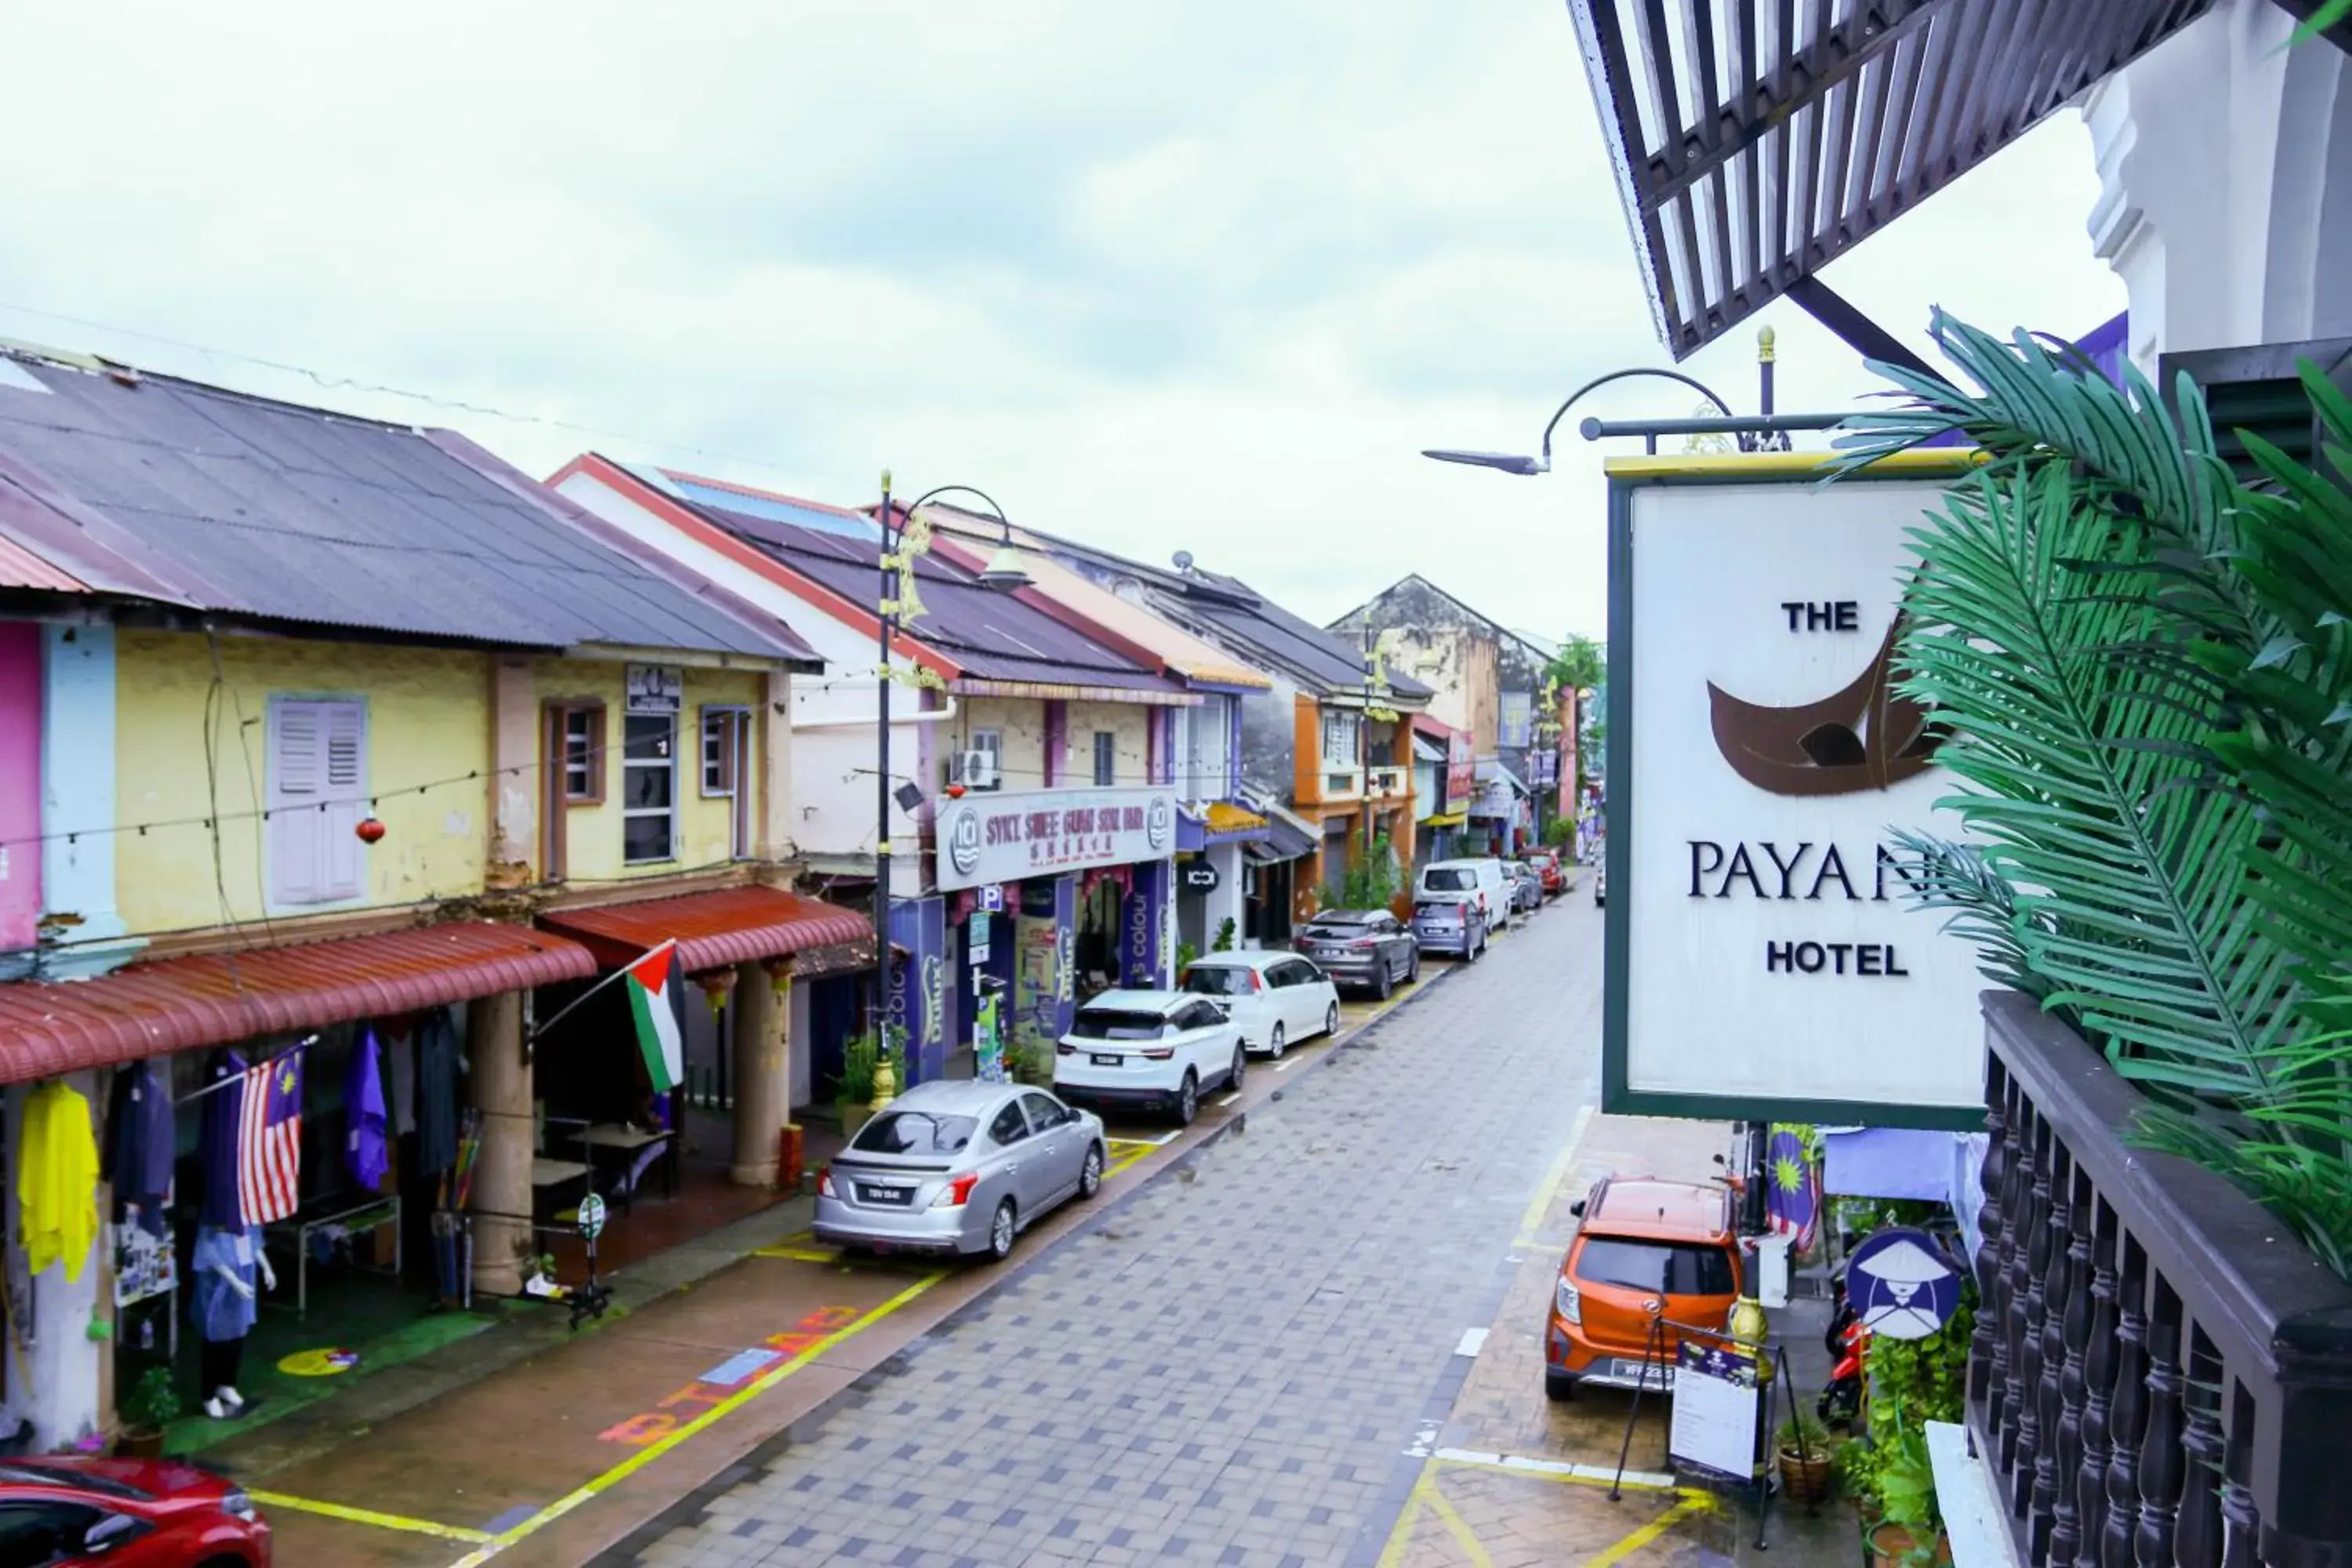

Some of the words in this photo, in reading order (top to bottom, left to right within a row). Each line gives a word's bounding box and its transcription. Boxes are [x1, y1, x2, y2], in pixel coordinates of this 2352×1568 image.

[1780, 601, 1859, 633] THE
[984, 887, 999, 909] P
[1130, 895, 1147, 950] colour
[1767, 940, 1909, 976] HOTEL
[927, 964, 942, 1044] Dulux
